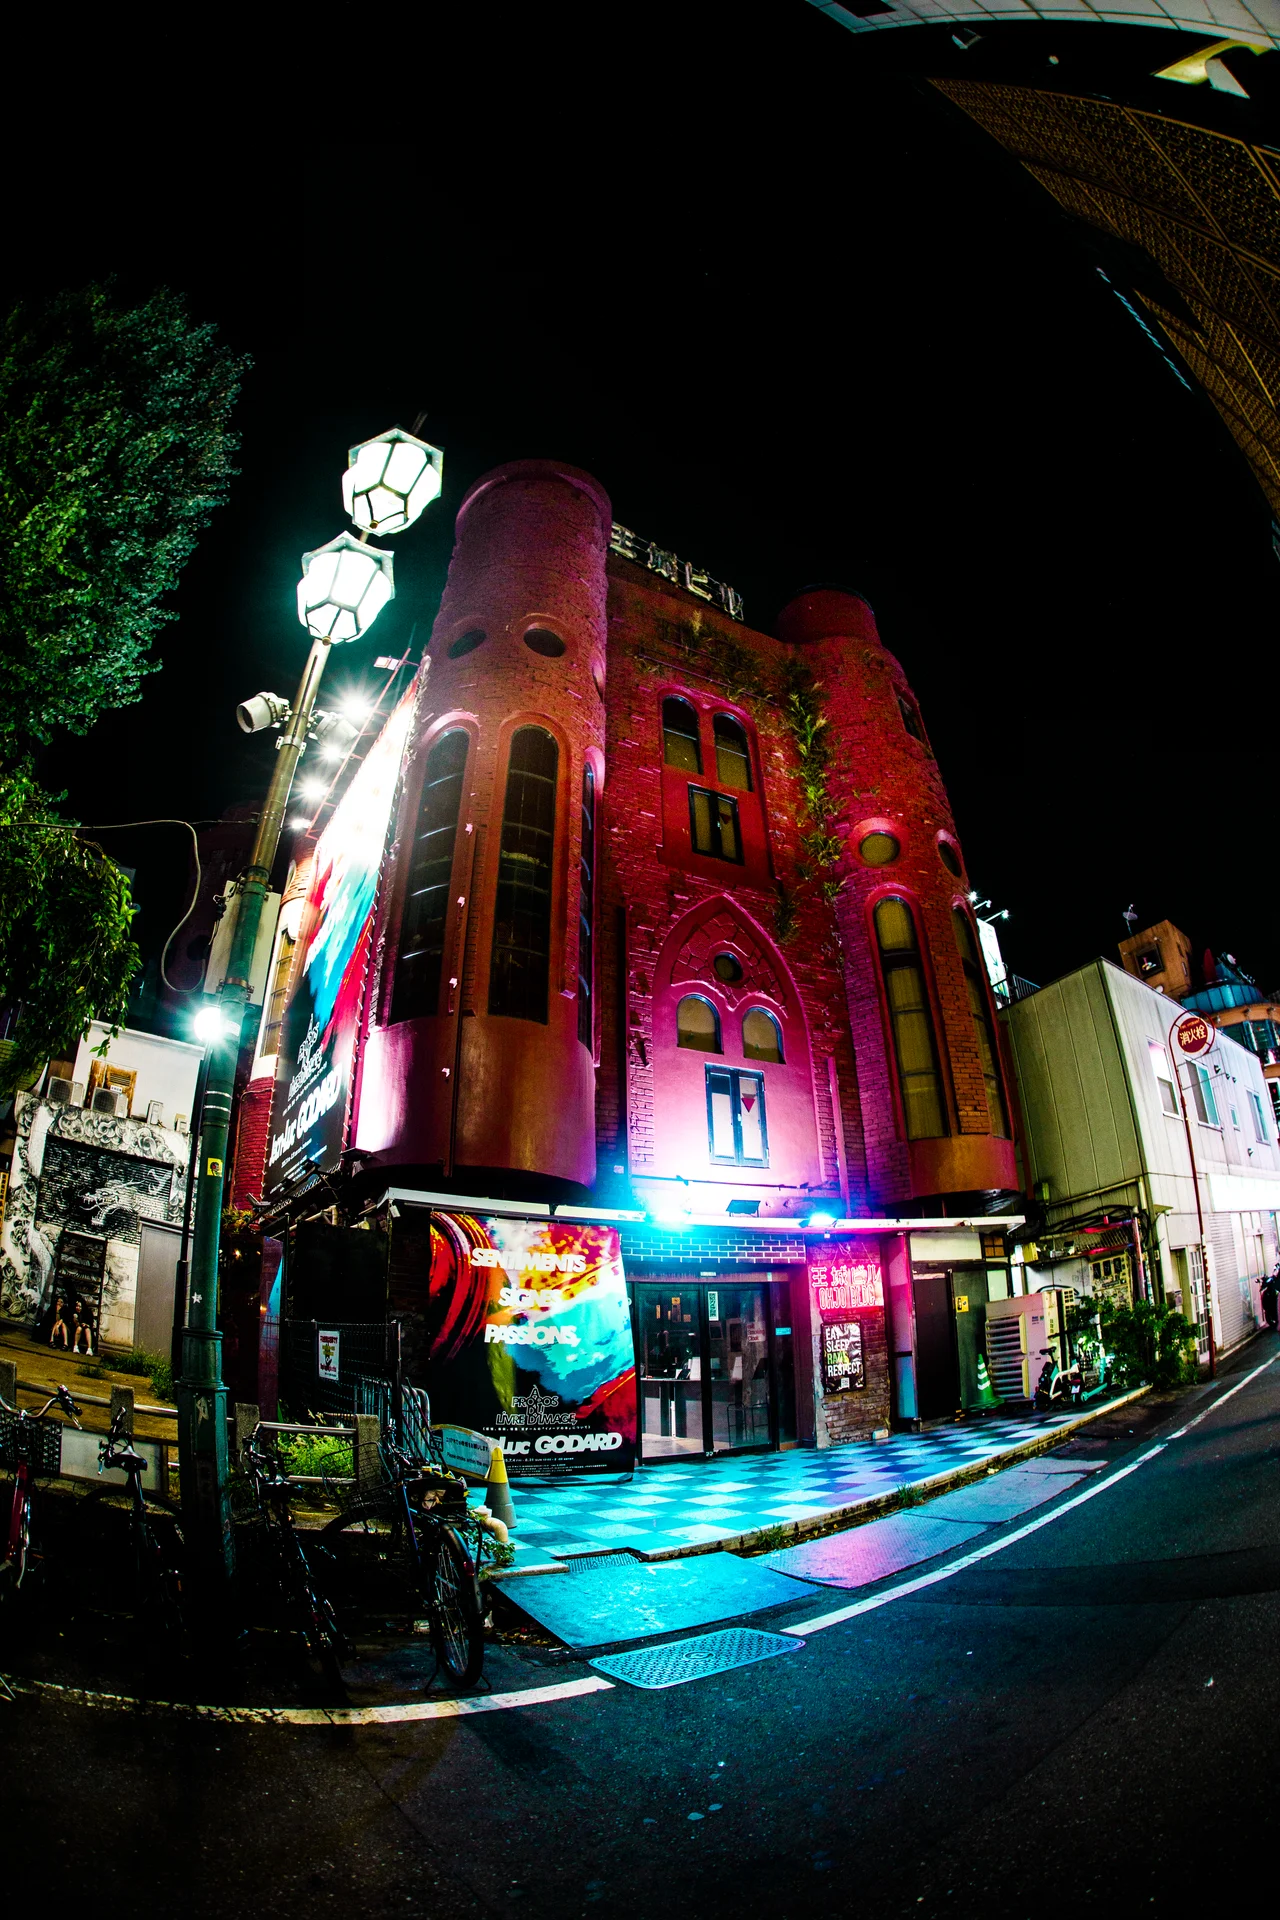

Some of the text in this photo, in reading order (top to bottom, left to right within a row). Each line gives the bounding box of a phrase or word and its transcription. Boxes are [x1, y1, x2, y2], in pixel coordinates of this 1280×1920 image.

[1179, 1025, 1206, 1046] 消火栓
[470, 1247, 587, 1273] SENTIMENTS
[811, 1264, 881, 1288] 王城ビル
[819, 1286, 847, 1310] OHJO
[826, 1339, 849, 1352] SLEEP
[828, 1361, 861, 1377] RESPECT
[534, 1432, 623, 1454] GODARD
